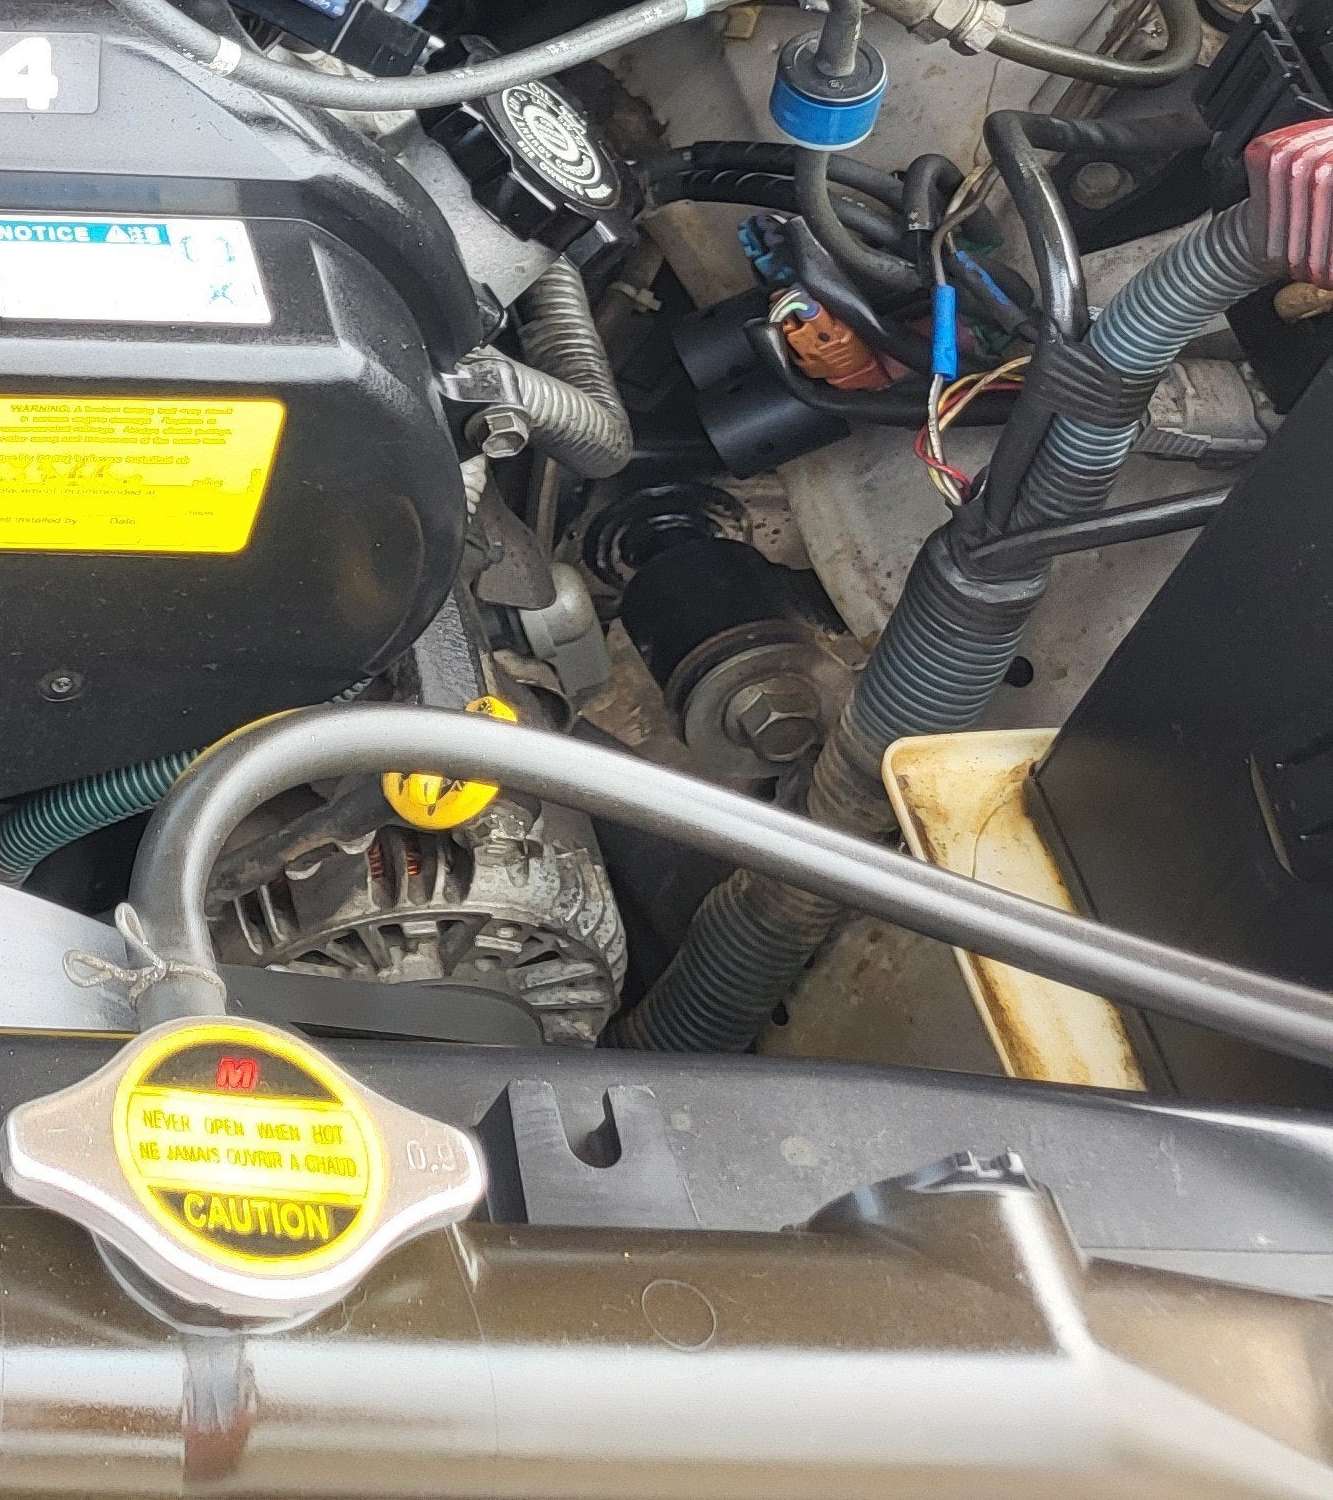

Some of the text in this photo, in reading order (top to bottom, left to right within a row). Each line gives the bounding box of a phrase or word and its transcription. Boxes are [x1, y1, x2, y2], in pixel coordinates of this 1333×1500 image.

[215, 1056, 259, 1090] M
[141, 1109, 191, 1133] NEVER
[204, 1116, 246, 1137] OPEN
[310, 1124, 344, 1146] HOT
[138, 1140, 160, 1160] NE
[183, 1192, 331, 1241] CAUTION
